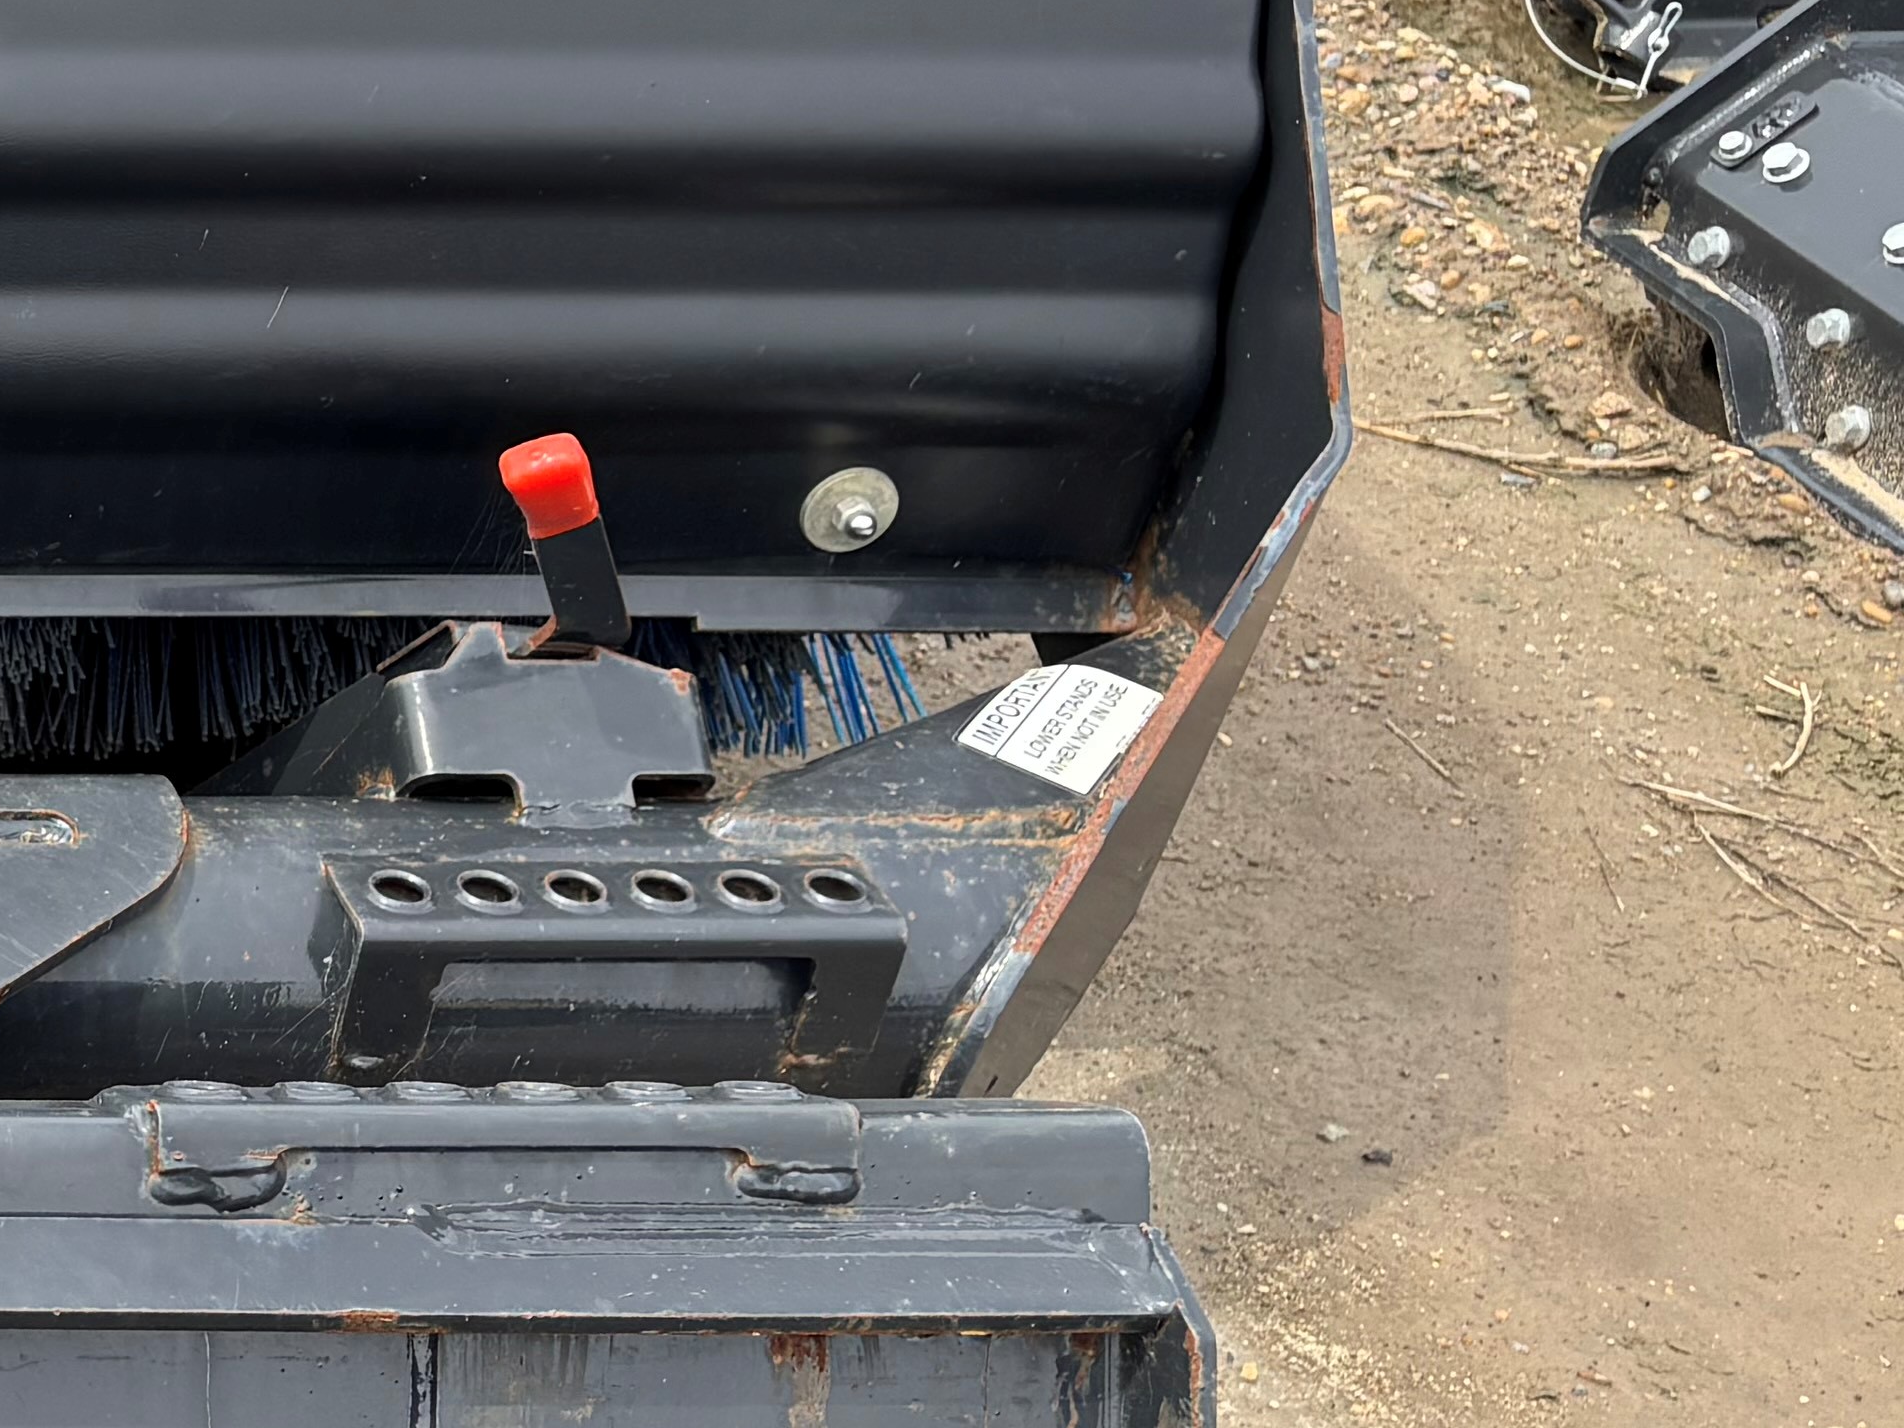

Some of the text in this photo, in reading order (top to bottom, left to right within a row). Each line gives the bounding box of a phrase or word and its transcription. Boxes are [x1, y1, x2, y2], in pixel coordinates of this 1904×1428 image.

[1024, 678, 1099, 759] LOWER STANDS
[1045, 742, 1083, 775] WHEN
[1071, 717, 1099, 744] NOT
[1089, 706, 1110, 722] IN
